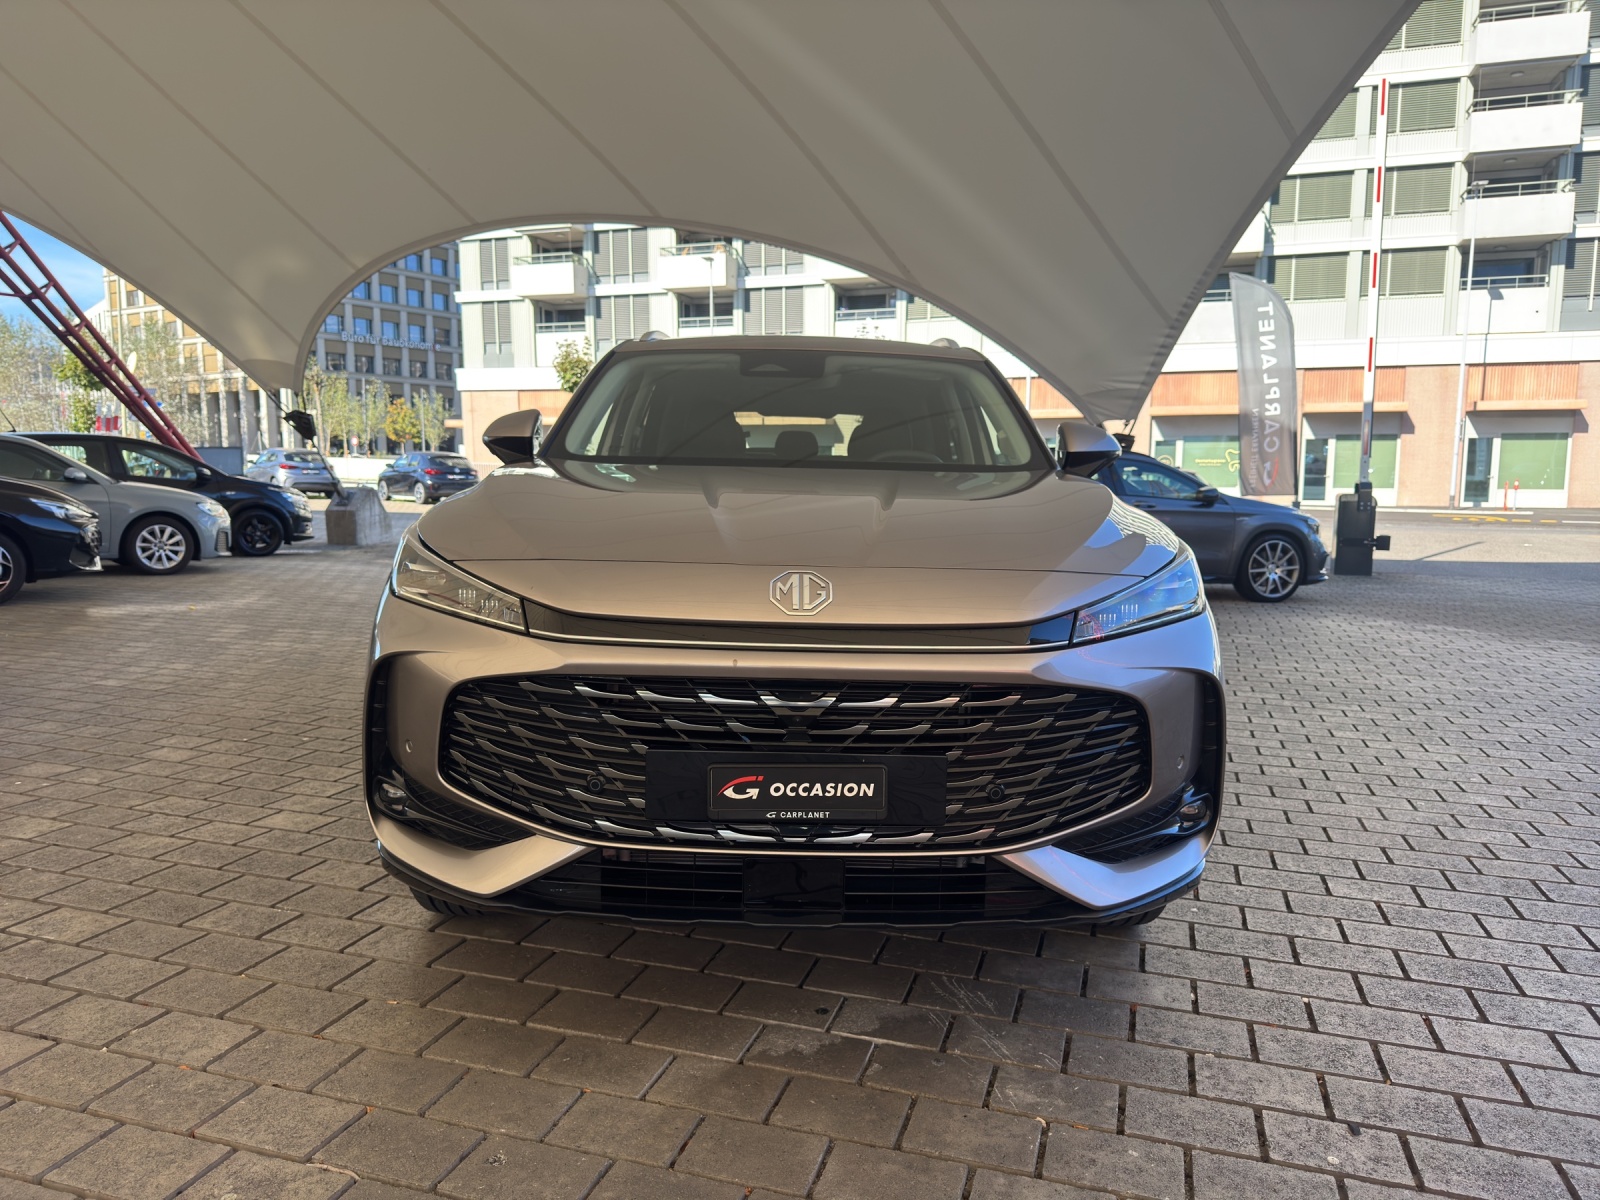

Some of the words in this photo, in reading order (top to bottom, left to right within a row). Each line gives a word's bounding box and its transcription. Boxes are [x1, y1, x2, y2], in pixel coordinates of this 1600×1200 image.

[341, 331, 365, 343] Büro
[366, 332, 380, 345] für
[381, 336, 441, 352] Bauökonomie
[774, 573, 828, 611] MG
[769, 782, 875, 798] OCCASION
[779, 811, 831, 819] CARPLANET
